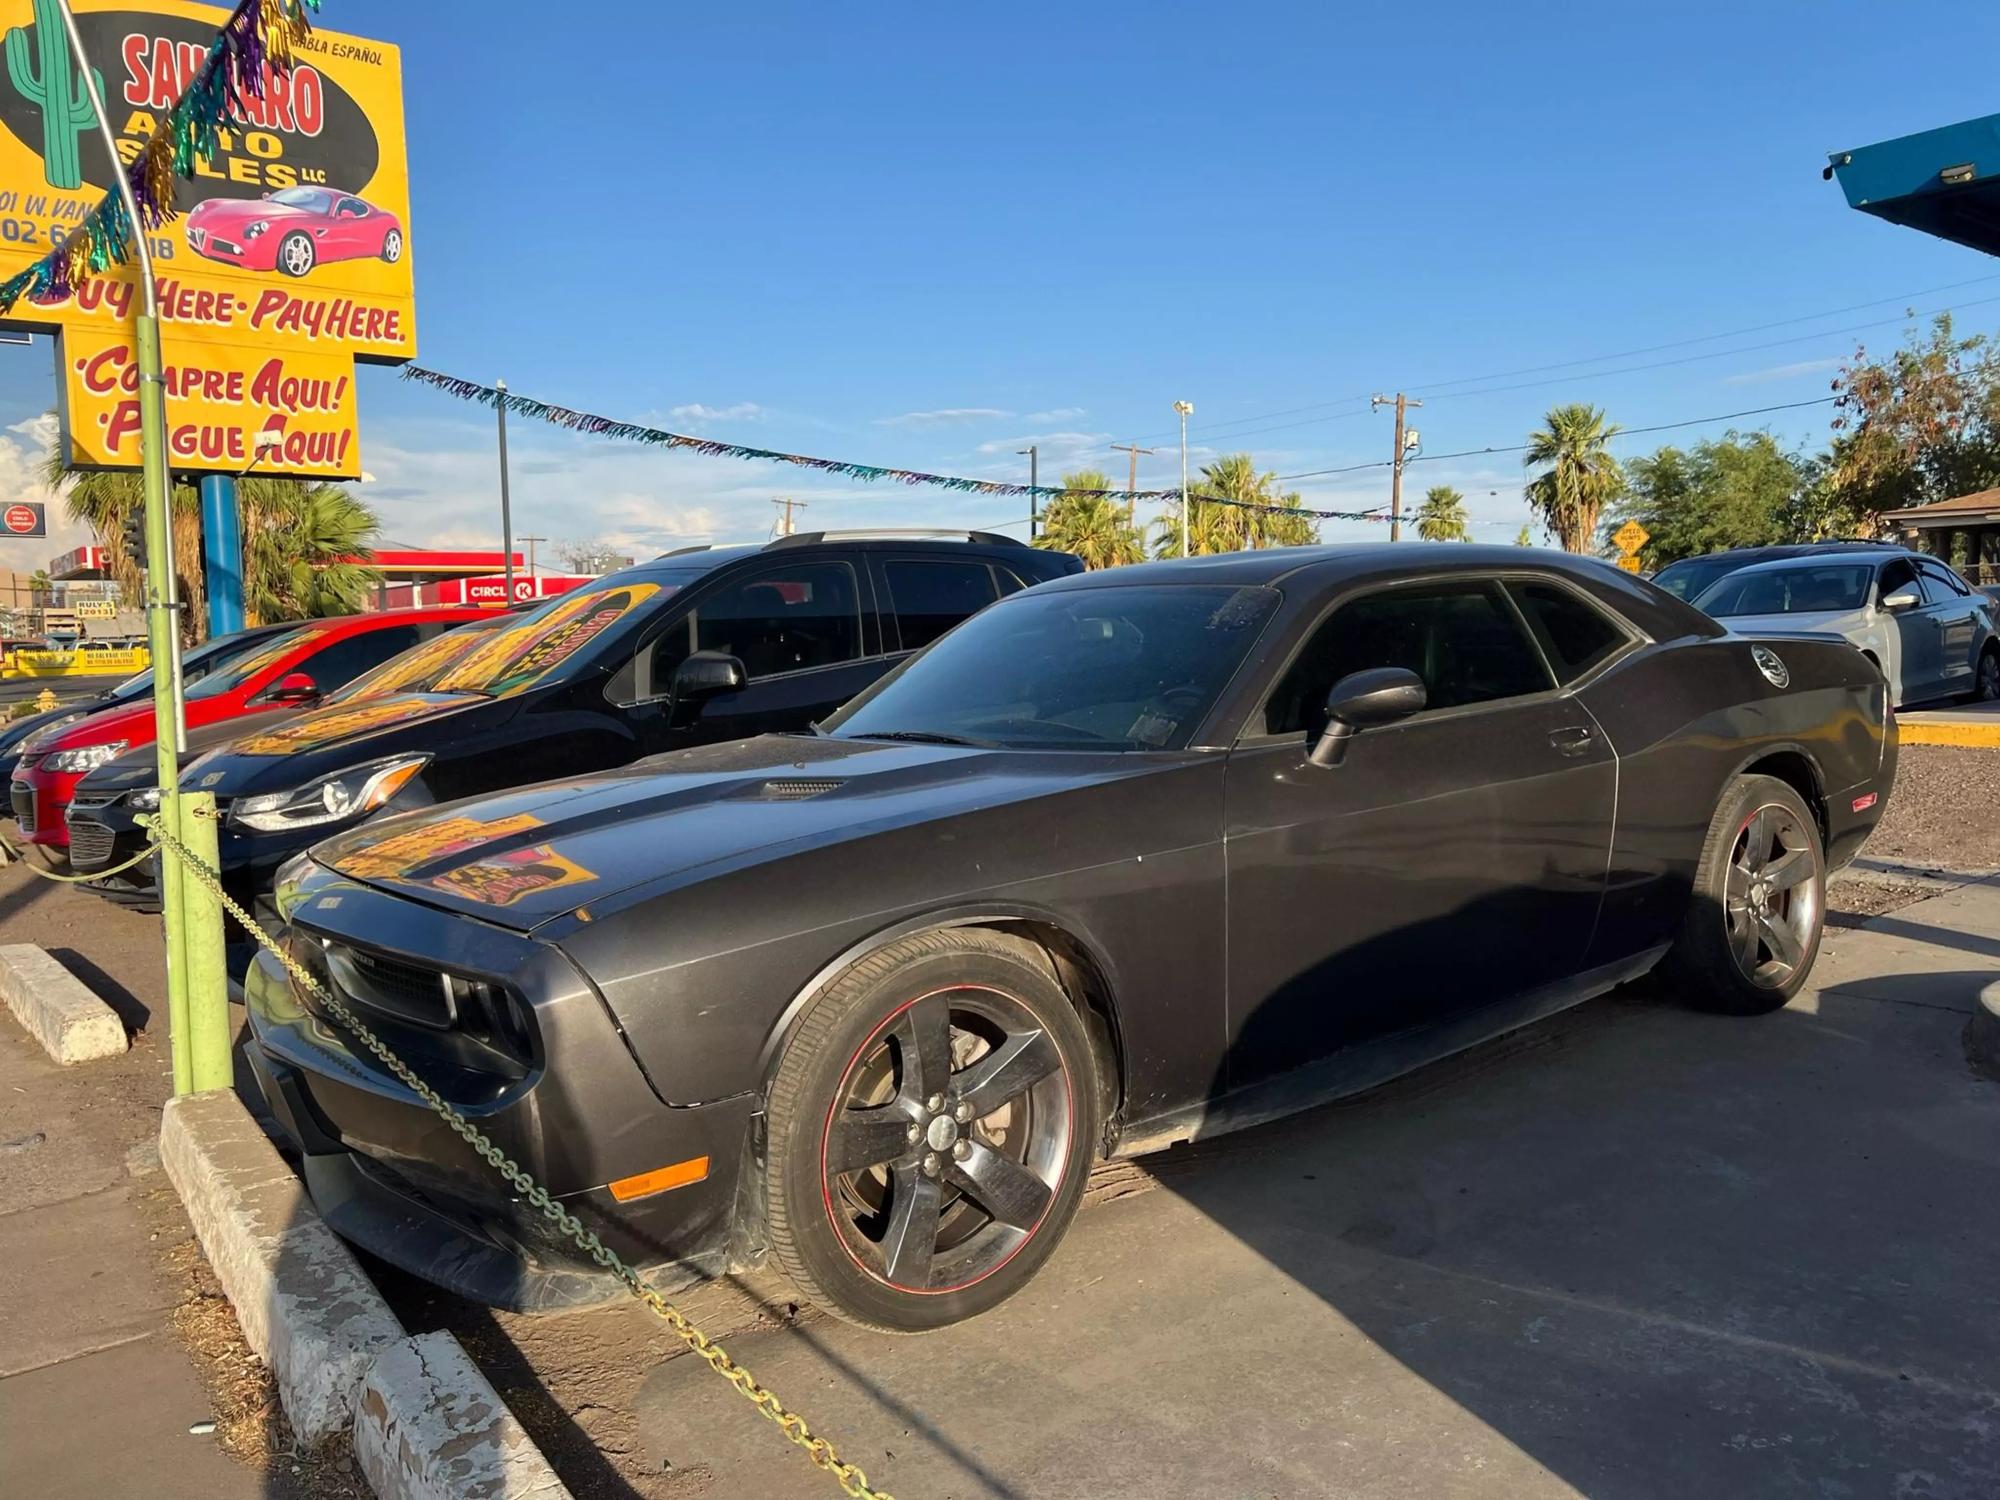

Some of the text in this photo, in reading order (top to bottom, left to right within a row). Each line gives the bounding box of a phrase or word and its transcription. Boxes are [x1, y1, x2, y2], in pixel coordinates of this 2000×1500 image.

[332, 42, 382, 65] ESPAÑOL
[115, 139, 325, 189] SLES LLC
[28, 277, 134, 317] UY
[250, 290, 326, 338] PAY
[251, 359, 348, 413] AQUI!
[106, 401, 244, 459] PGUE
[471, 584, 531, 599] CIRCL K
